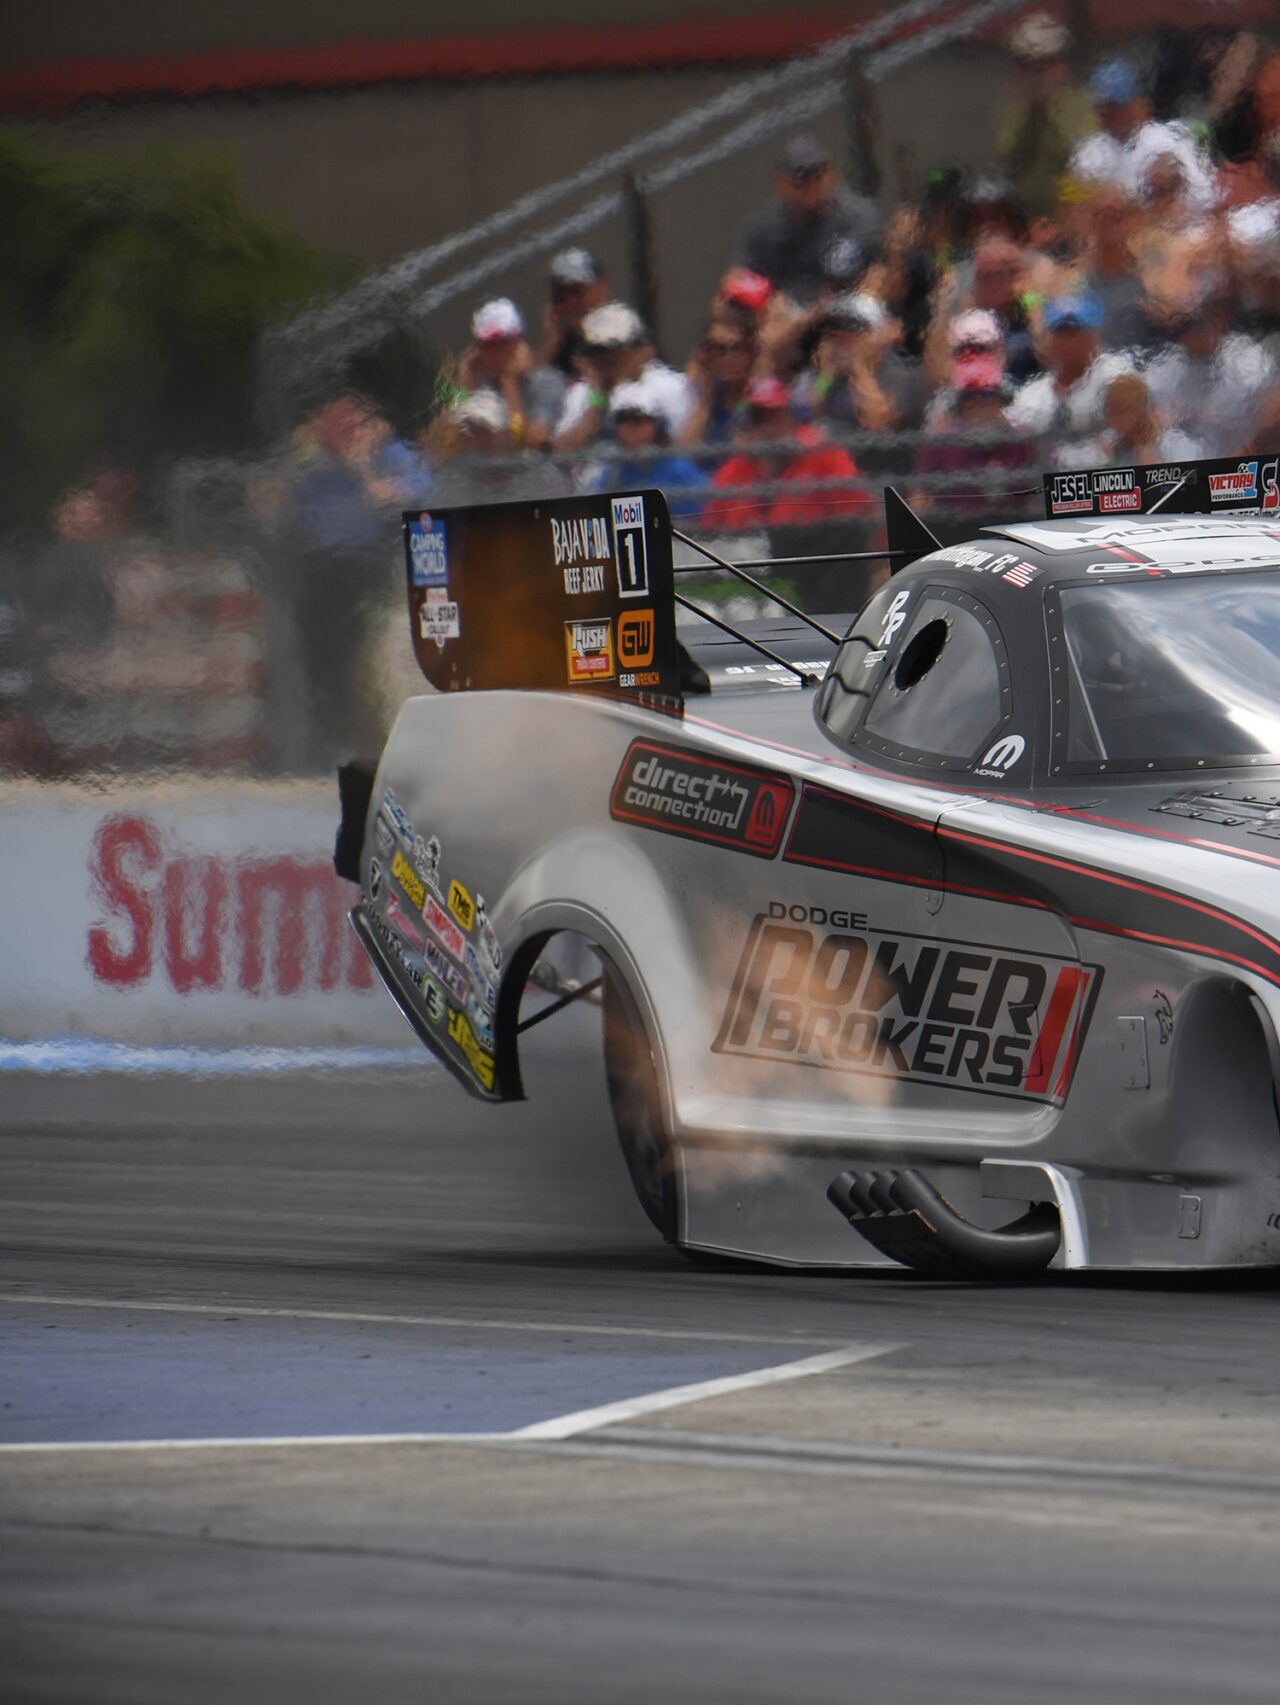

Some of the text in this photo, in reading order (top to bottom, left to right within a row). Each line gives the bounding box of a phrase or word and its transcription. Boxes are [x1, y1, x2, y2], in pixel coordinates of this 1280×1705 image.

[1051, 474, 1092, 503] JESEL
[1094, 473, 1133, 493] LINCOLN
[1146, 467, 1182, 484] TREND
[1210, 473, 1254, 490] VICTORY
[614, 502, 643, 524] Mobil
[1103, 494, 1138, 509] ELECTRIC
[550, 518, 583, 566] BAJA
[412, 551, 446, 576] WORLD
[624, 533, 638, 586] 1
[563, 565, 605, 594] BEEF JERKY
[632, 757, 727, 802] direct
[624, 785, 742, 830] connection
[87, 815, 375, 995] Sum
[768, 901, 869, 931] DODGE
[729, 924, 1047, 1047] POWER
[759, 1001, 1032, 1087] BROKERS
